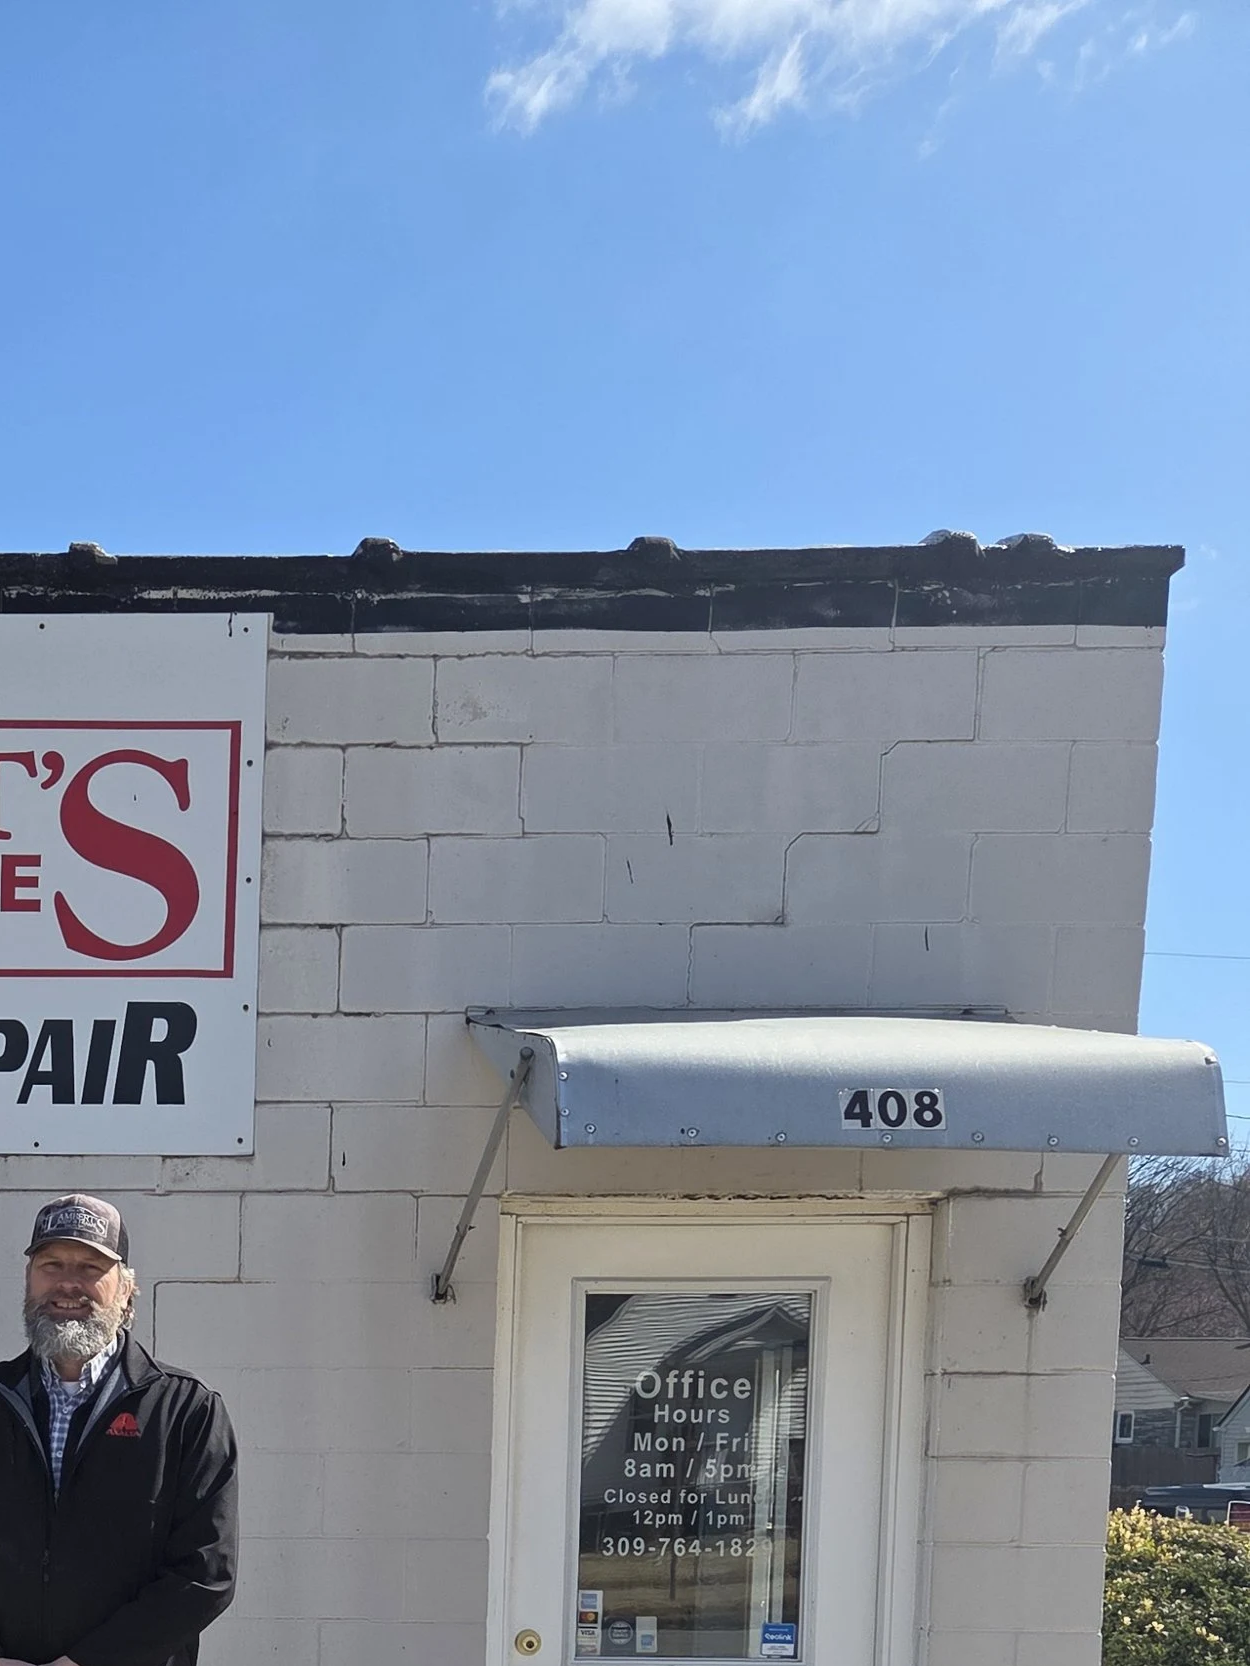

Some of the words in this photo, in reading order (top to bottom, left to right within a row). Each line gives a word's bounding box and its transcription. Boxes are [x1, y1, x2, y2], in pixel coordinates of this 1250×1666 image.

[843, 1089, 943, 1128] 408
[635, 1369, 752, 1400] Office
[653, 1403, 730, 1424] Hours
[633, 1432, 685, 1451] Mon
[696, 1432, 705, 1452] /
[715, 1432, 749, 1452] Fri
[624, 1458, 675, 1478] 8am
[685, 1457, 695, 1479] /
[704, 1457, 756, 1483] 5pm
[603, 1488, 672, 1504] Closed
[679, 1488, 707, 1504] for
[632, 1509, 683, 1529] 12pm
[690, 1509, 698, 1526] /
[705, 1510, 745, 1529] 1pm
